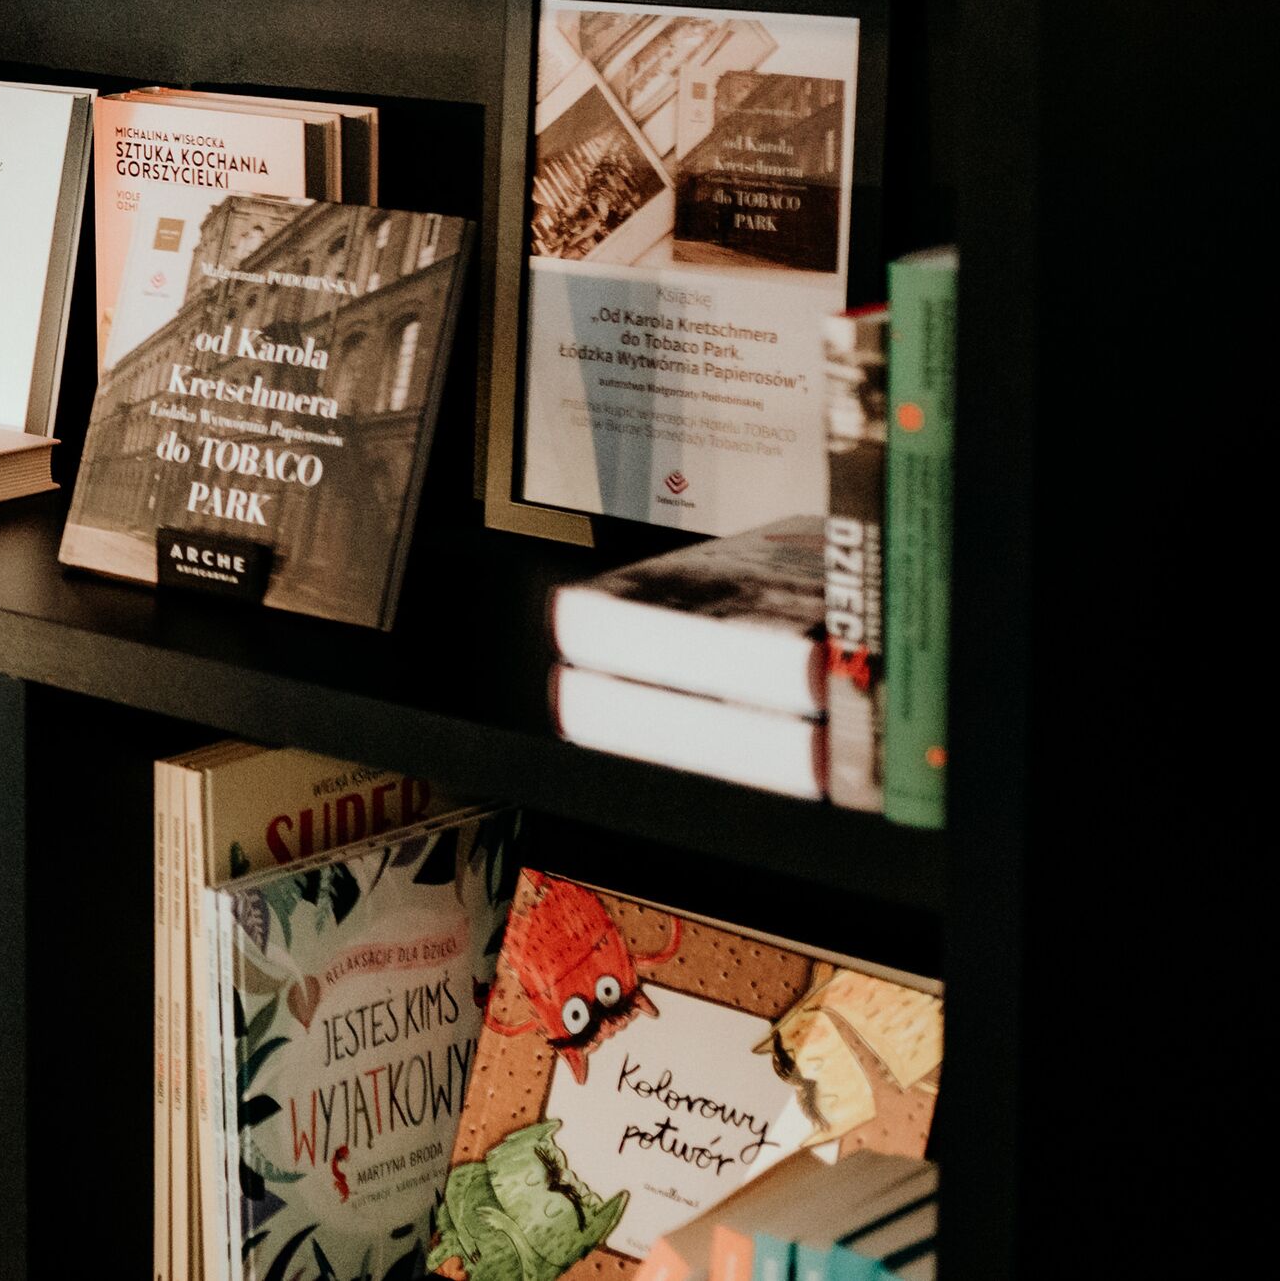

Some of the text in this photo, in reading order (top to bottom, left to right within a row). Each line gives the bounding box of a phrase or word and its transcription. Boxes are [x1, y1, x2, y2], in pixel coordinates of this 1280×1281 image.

[115, 126, 225, 148] MICHALINA WISŁOCKA
[116, 140, 269, 175] SZTUKA KOCHANIA
[116, 159, 230, 189] GORSZYCIELKI
[734, 189, 802, 212] TOBACO
[733, 212, 778, 232] PARK
[623, 309, 674, 331] Karola
[678, 317, 778, 345] Kretschmera
[645, 332, 699, 355] Tobaco
[195, 325, 329, 370] od Karola
[559, 342, 699, 376] Łódzka Wytwórnia
[167, 363, 339, 418] Kretschmera
[156, 430, 324, 487] do TOBACO
[186, 480, 271, 527] PARK
[170, 544, 246, 573] ARCHE
[326, 954, 394, 985] RELAKSACJE
[397, 948, 419, 965] DLA
[322, 970, 460, 1067] JESTEŚ KIMŚ
[618, 1052, 781, 1165] Kolorowy
[356, 1142, 444, 1186] MARTYNA BRODA
[619, 1117, 734, 1176] potwór
